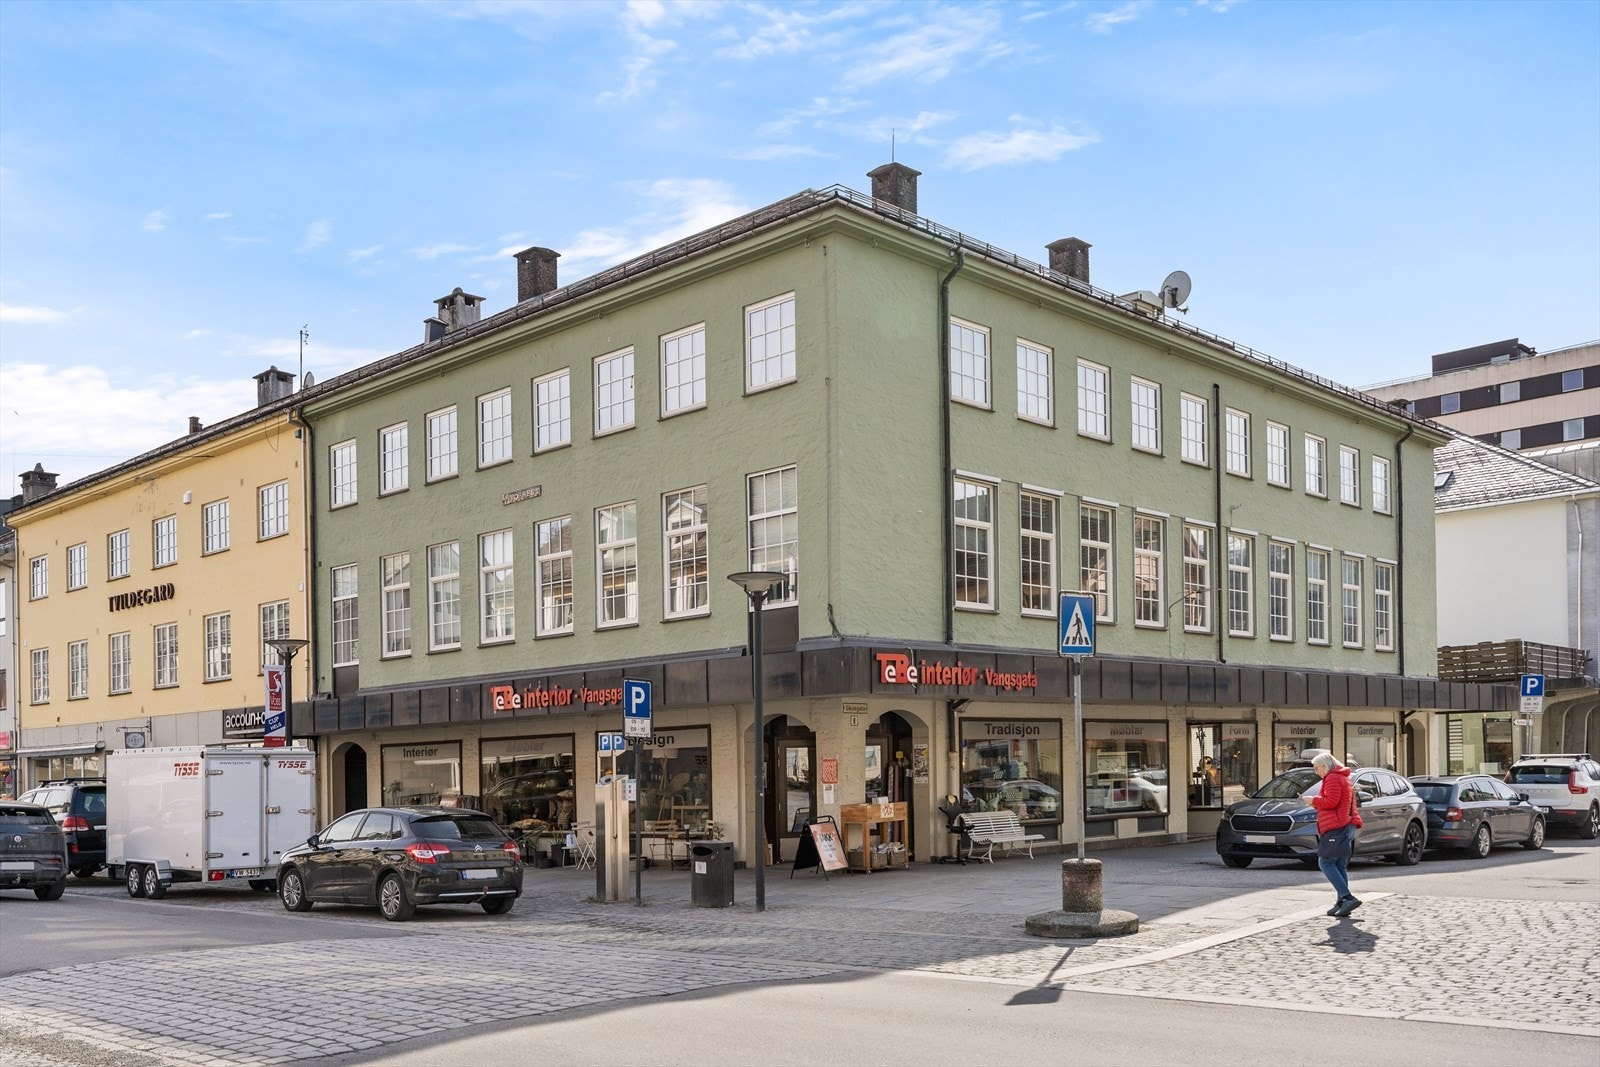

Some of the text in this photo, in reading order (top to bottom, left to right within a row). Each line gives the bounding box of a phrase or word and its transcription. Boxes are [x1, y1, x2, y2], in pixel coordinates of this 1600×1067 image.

[108, 583, 175, 612] TVILDEGARD
[922, 659, 978, 686] interiør
[985, 668, 1038, 691] Vangsgata
[1526, 678, 1539, 694] P
[523, 685, 573, 709] interiør
[580, 687, 623, 706] Vangsga
[631, 686, 646, 714] P
[985, 723, 1040, 737] Tradisjon
[1110, 725, 1144, 735] Møblar
[1229, 725, 1250, 735] Form
[1290, 725, 1316, 735] Interiør
[1357, 726, 1384, 735] Gardiner
[601, 736, 609, 750] P
[614, 736, 622, 749] P
[403, 748, 438, 758] Interiør
[278, 761, 307, 769] TYSSE
